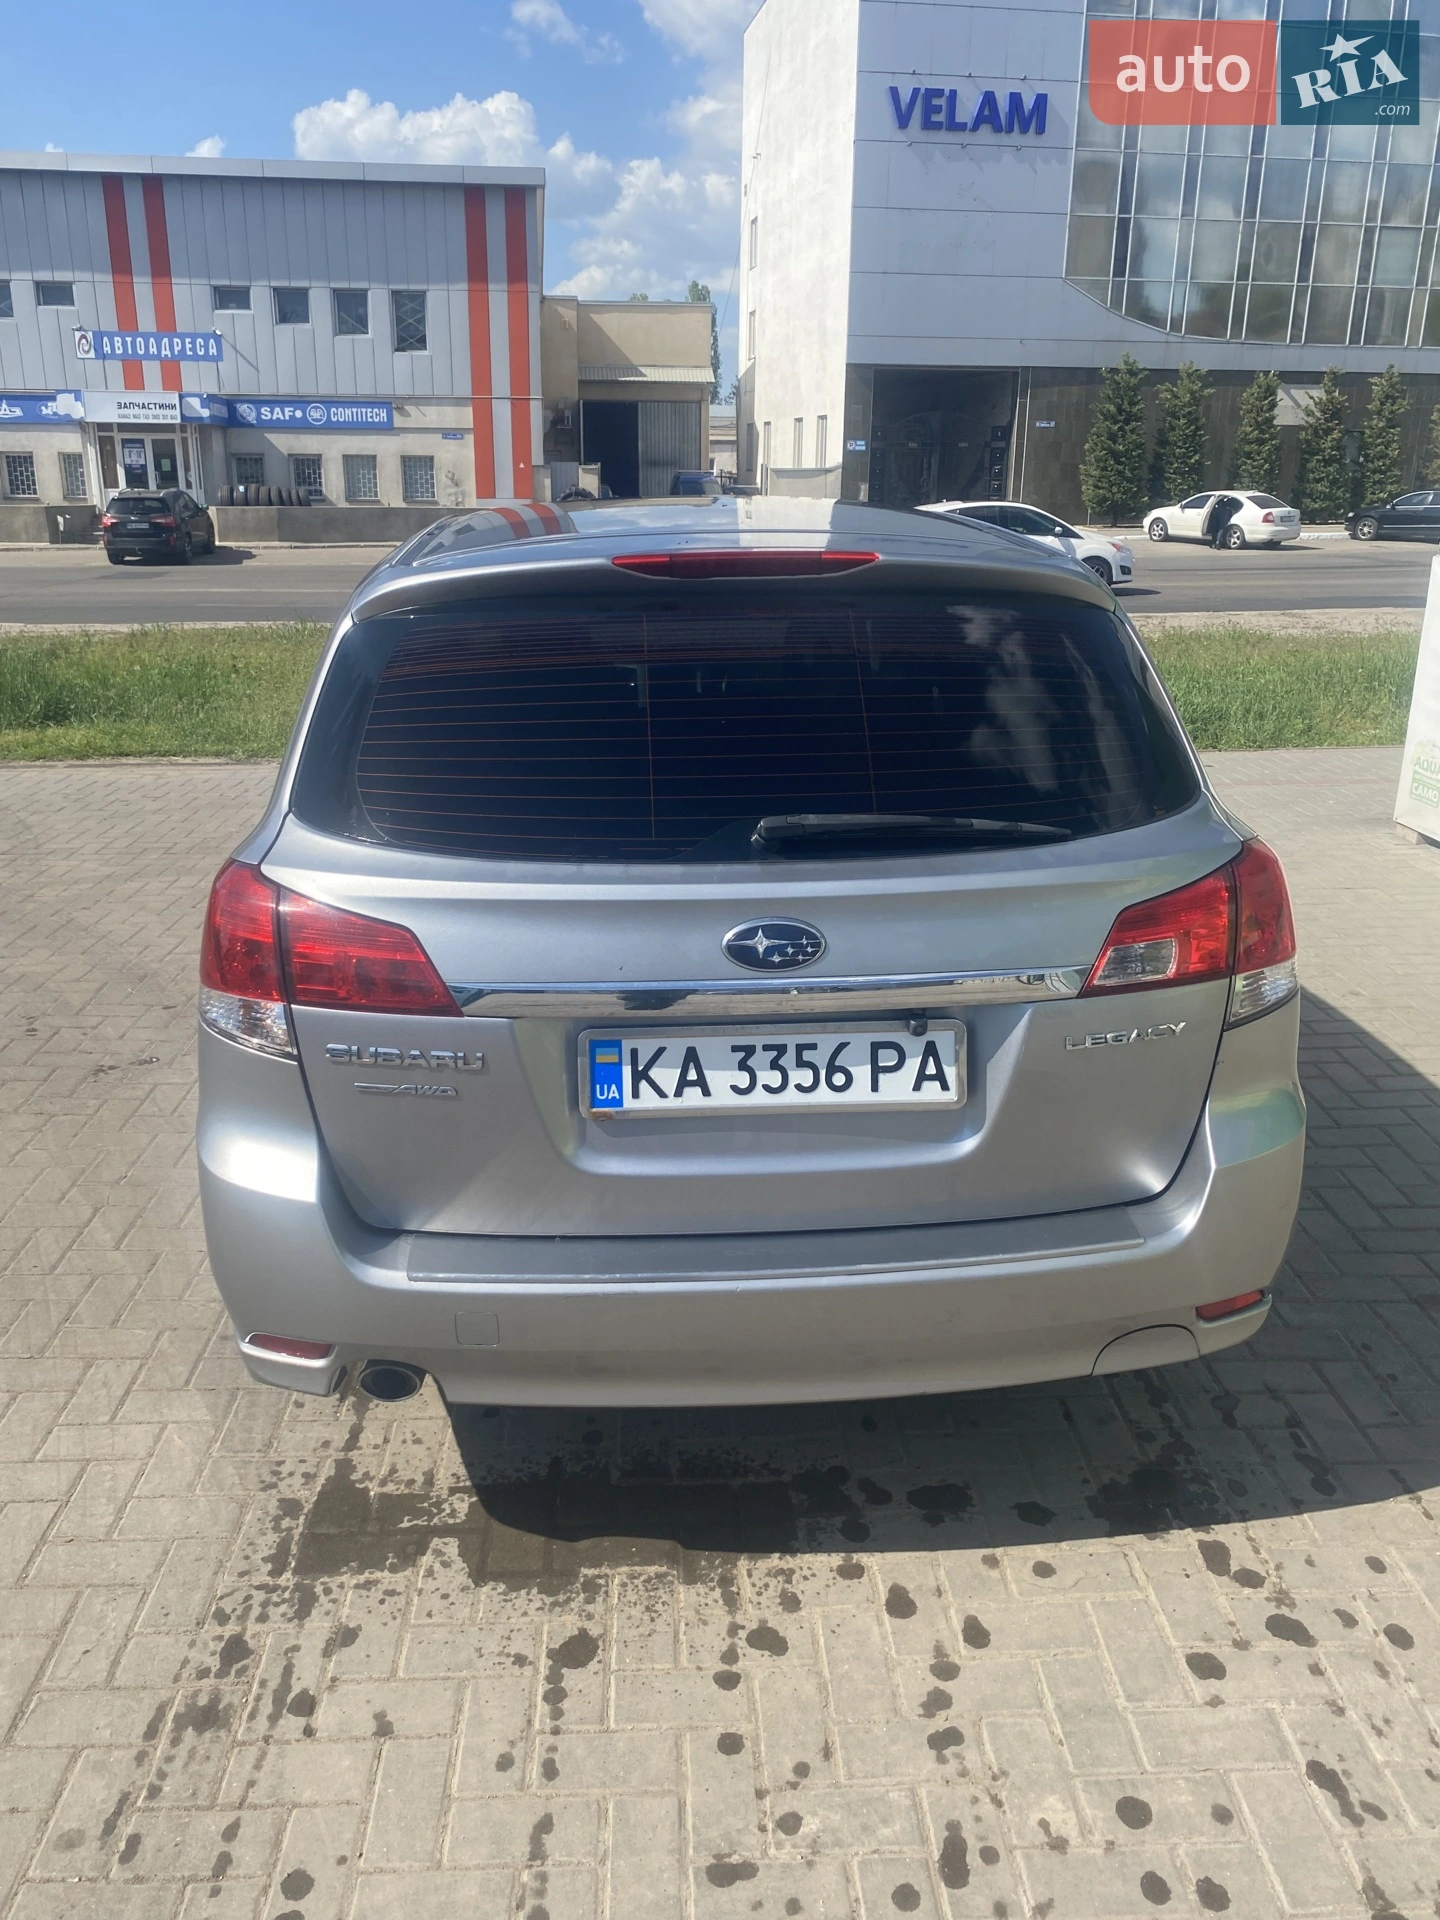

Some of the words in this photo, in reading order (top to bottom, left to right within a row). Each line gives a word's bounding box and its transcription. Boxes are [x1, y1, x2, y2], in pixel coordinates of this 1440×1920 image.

[889, 86, 1048, 135] VELAM
[103, 336, 217, 358] АВТОАДРЕСА
[117, 401, 177, 411] ЗАПЧАСТИНИ
[330, 407, 388, 423] CONTITECH
[1065, 1021, 1187, 1050] LEGACY
[325, 1043, 485, 1070] SUBARU
[630, 1046, 712, 1099] KA
[729, 1042, 854, 1096] 3356
[870, 1040, 950, 1093] PA
[392, 1084, 458, 1096] AWD
[596, 1084, 620, 1100] UA
